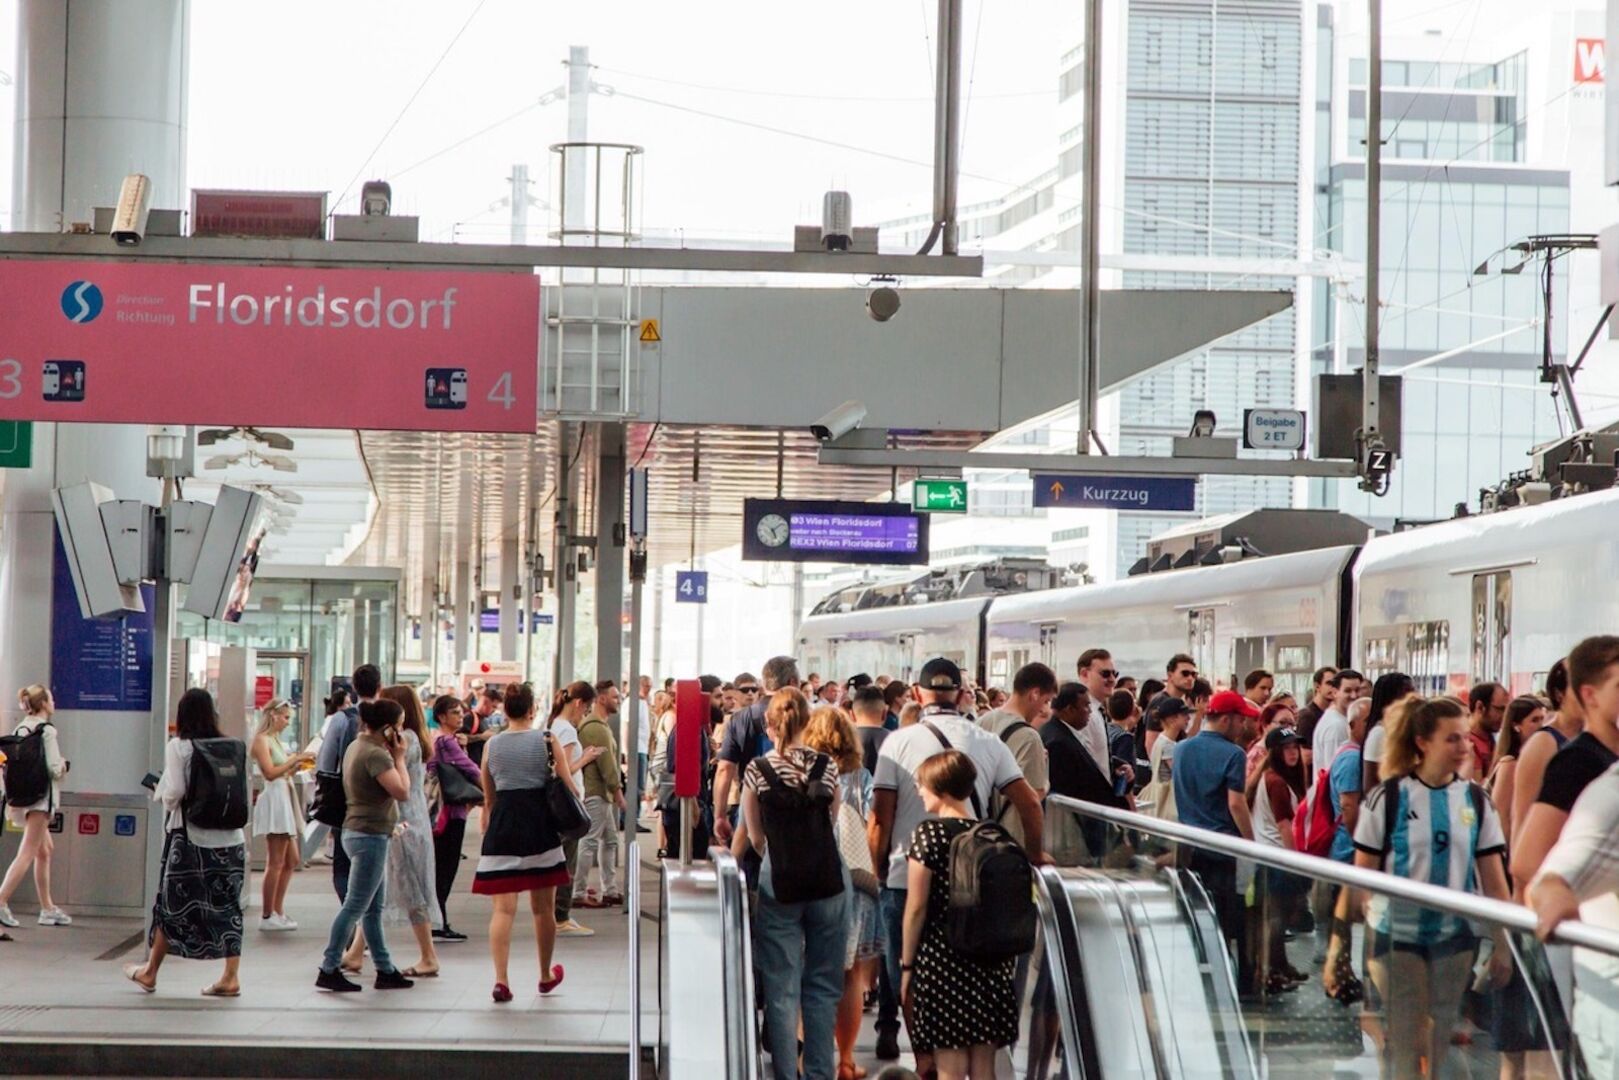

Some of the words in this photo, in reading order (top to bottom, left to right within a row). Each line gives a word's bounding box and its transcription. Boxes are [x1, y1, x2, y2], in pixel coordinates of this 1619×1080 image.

[188, 282, 459, 329] Floridsdorf
[116, 311, 175, 326] Richtung
[0, 358, 21, 399] 3
[487, 371, 516, 410] 4
[1255, 416, 1297, 428] Beigabe
[1264, 432, 1271, 440] 2
[1273, 432, 1287, 441] ET
[1372, 452, 1387, 469] Z
[1083, 486, 1149, 504] Kurzzug
[806, 517, 829, 526] Wien
[817, 539, 840, 548] Wien
[680, 579, 693, 595] 4
[1435, 831, 1449, 855] 9
